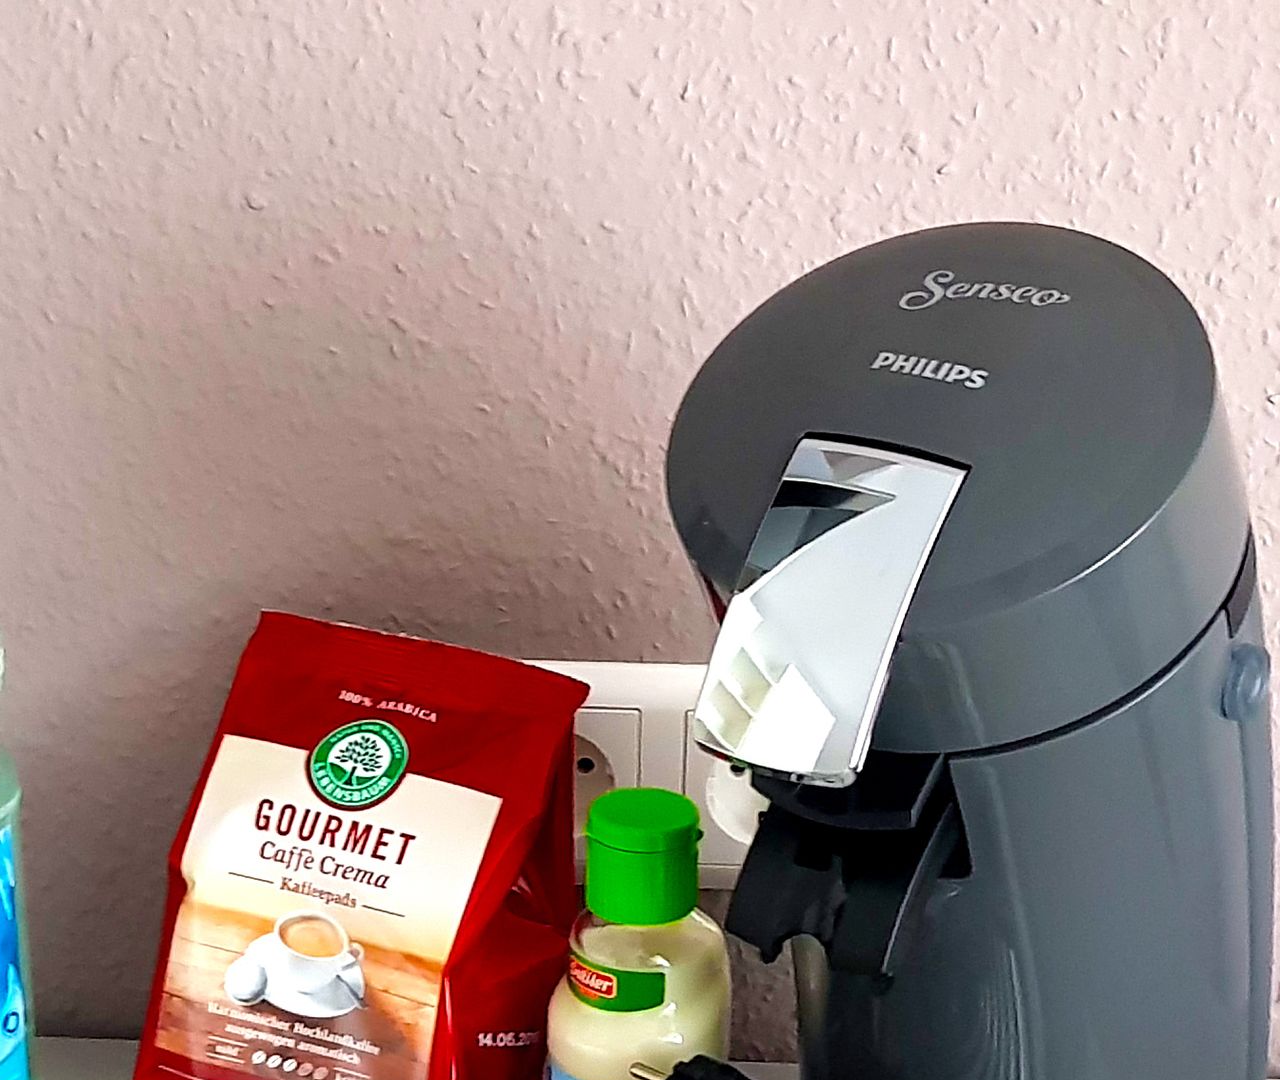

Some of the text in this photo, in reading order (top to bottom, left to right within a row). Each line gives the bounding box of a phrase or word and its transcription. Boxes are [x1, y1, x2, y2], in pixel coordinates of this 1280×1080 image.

[898, 270, 1071, 311] Senseo
[870, 351, 990, 390] PHILIPS
[338, 690, 438, 722] 100% ARABICA
[255, 798, 416, 865] GOURMET
[319, 855, 390, 889] Crema
[279, 876, 357, 908] Kaffeepads
